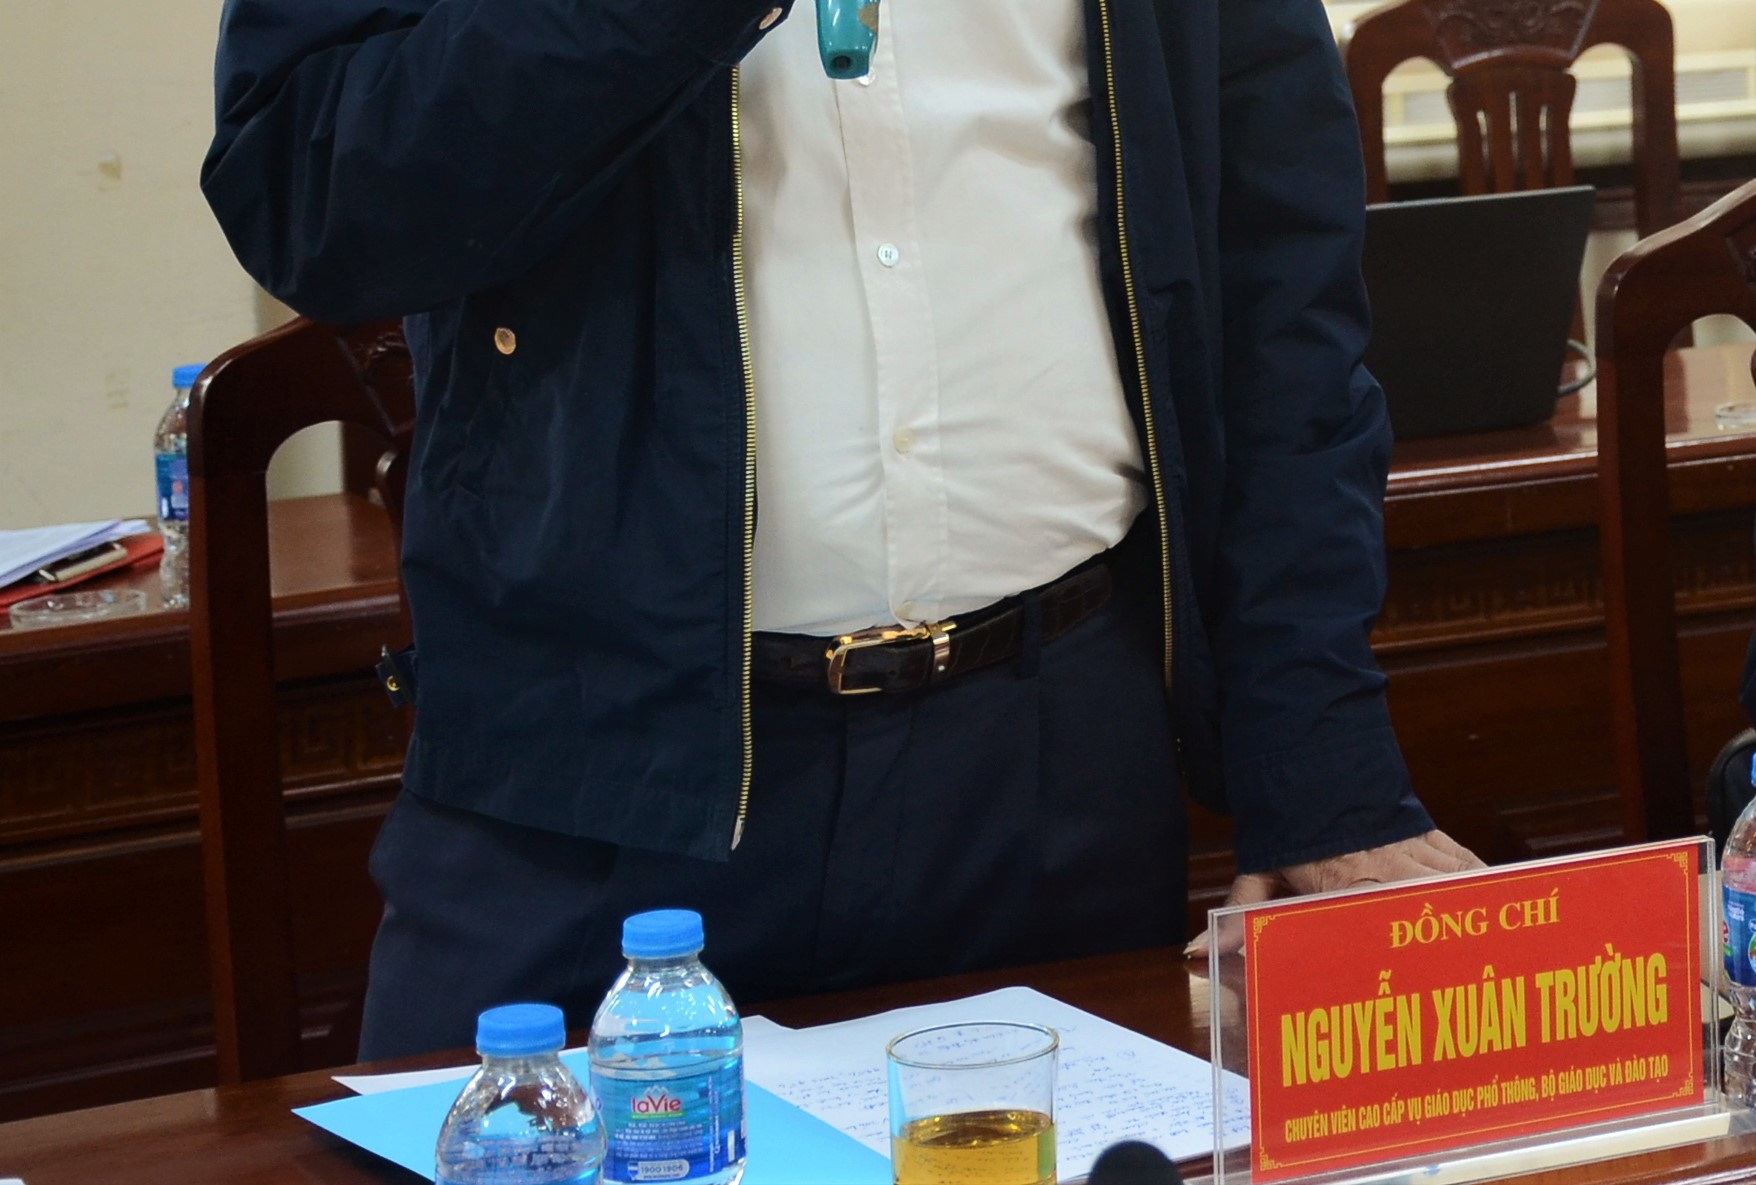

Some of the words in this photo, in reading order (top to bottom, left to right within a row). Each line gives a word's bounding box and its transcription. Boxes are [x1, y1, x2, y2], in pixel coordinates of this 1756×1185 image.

[1391, 902, 1488, 948] ĐỒNG
[1499, 888, 1560, 930] CHÍ
[1281, 969, 1422, 1088] NGUYỄN
[1432, 965, 1526, 1062] XUÂN
[1535, 943, 1669, 1044] TRƯỜNG
[1285, 1109, 1329, 1143] CHUYÊN
[1330, 1104, 1357, 1135] VIÊN
[1358, 1104, 1381, 1130] CAO
[1383, 1092, 1406, 1126] CẤP
[1407, 1096, 1423, 1126] VỤ
[1424, 1088, 1451, 1119] GIÁO
[1452, 1087, 1475, 1117] DỤC
[1476, 1074, 1499, 1109] PHỔ
[1500, 1075, 1540, 1105] THÔNG,
[1541, 1068, 1557, 1102] BỘ
[1558, 1065, 1584, 1095] GIÁO
[1585, 1064, 1608, 1094] DỤC
[1608, 1057, 1624, 1086] VÀ
[1624, 1054, 1647, 1083] ĐÀO
[1648, 1054, 1669, 1083] TẠO
